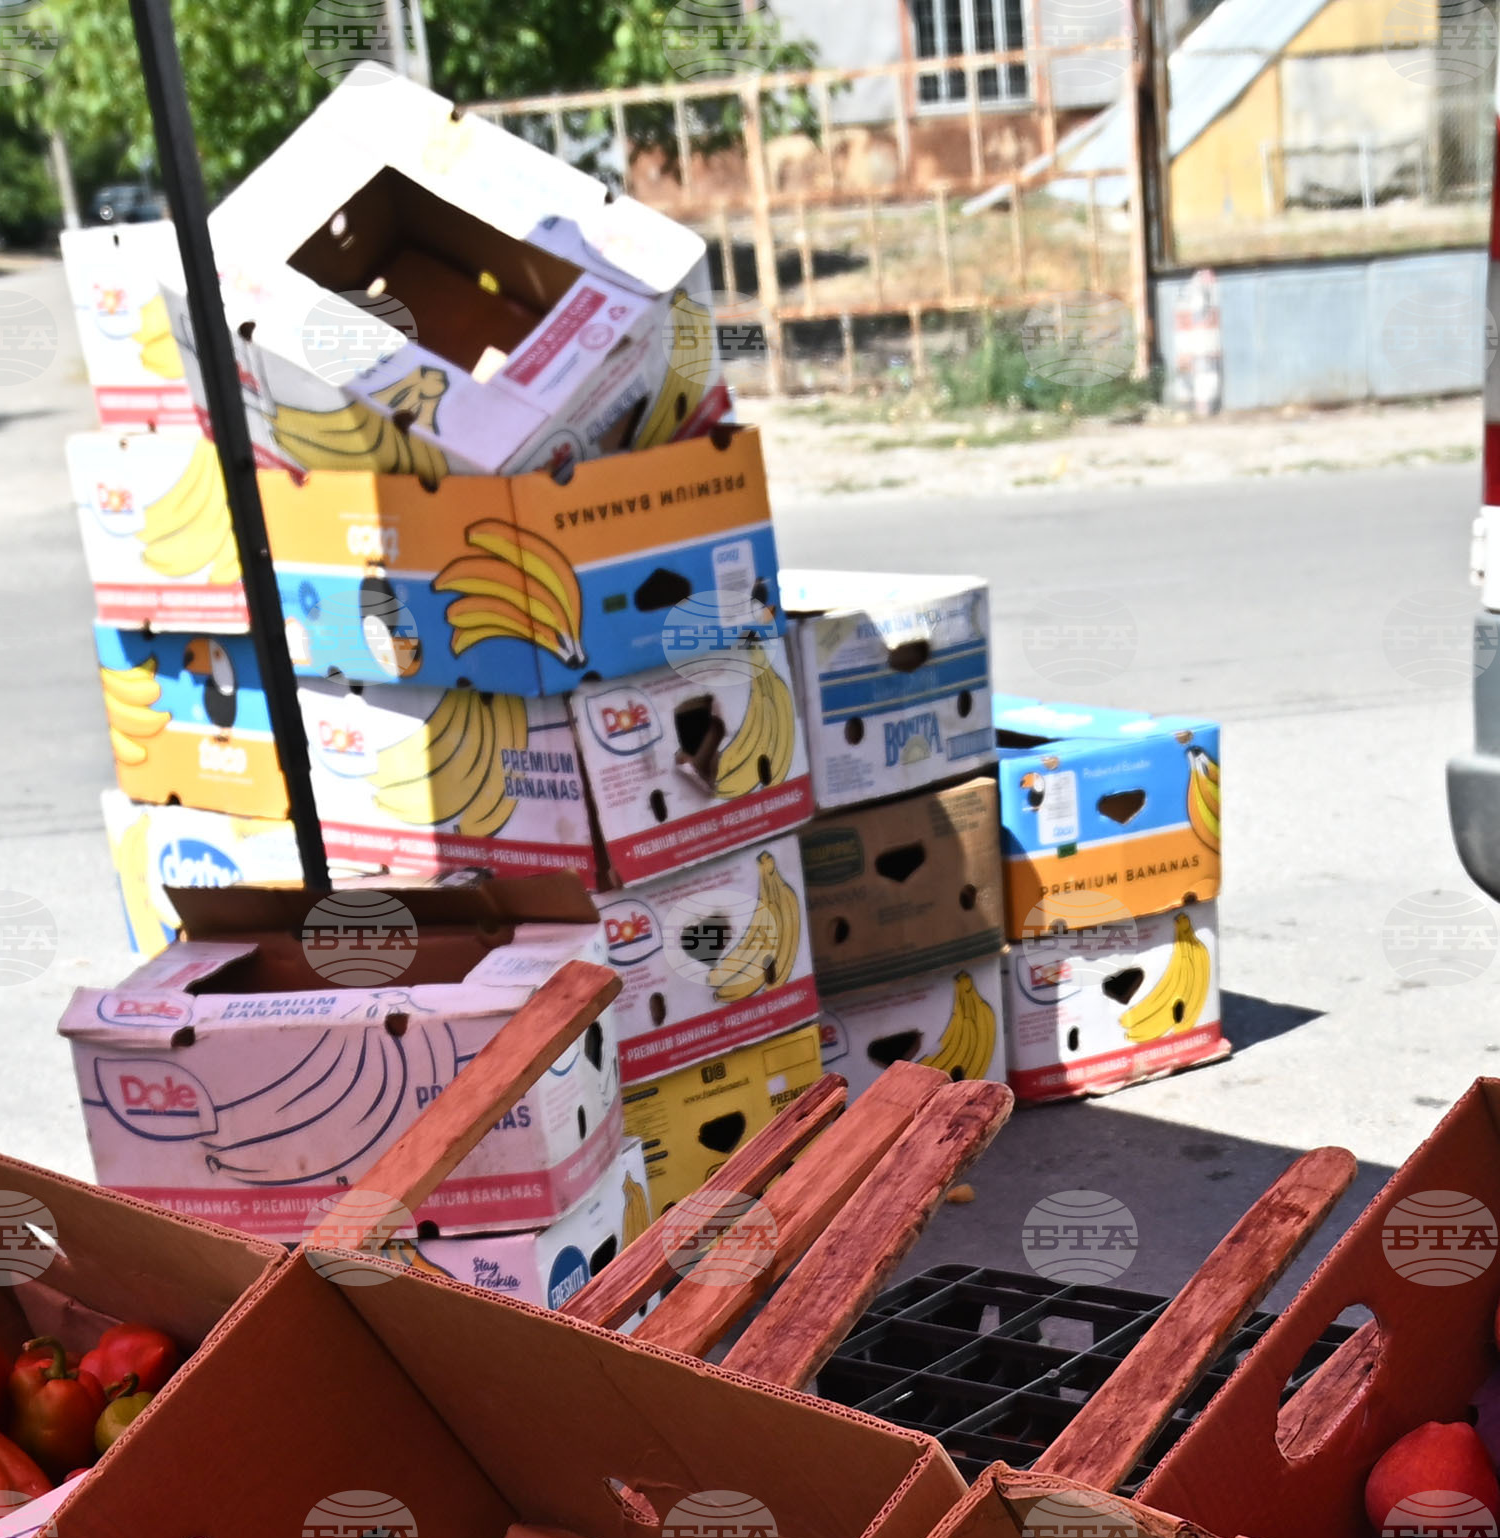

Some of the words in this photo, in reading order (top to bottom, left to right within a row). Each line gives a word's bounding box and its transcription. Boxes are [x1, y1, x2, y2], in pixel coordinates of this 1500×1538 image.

[661, 473, 746, 507] PREMIUM
[554, 493, 652, 530] BANANAS
[602, 700, 650, 733] Dole
[319, 720, 365, 751] Dole
[501, 749, 575, 774] PREMIUM
[503, 776, 580, 801] BANANAS
[633, 832, 677, 859] PREMIUM
[676, 819, 719, 845] BANANAS
[721, 802, 764, 828] PREMIUM
[764, 790, 800, 814] BANANAS
[442, 845, 488, 861] BANANAS
[492, 848, 539, 866] PREMIUM
[539, 853, 589, 870] BANANAS
[1040, 871, 1118, 898] PREMIUM
[1126, 855, 1201, 882] BANANAS
[604, 911, 651, 945] Dole
[114, 999, 184, 1018] Dole
[220, 1006, 332, 1020] BANANAS
[226, 996, 338, 1010] PREMIUM
[627, 1036, 673, 1061] PREMIUM
[674, 1022, 719, 1046] BANANAS
[724, 1005, 767, 1028] PREMIUM
[767, 989, 805, 1014] BANANAS
[119, 1075, 197, 1109] Dole
[472, 1183, 542, 1203] BANANAS
[253, 1197, 320, 1215] PREMIUM
[472, 1256, 500, 1275] Stay
[475, 1273, 522, 1288] Freskita
